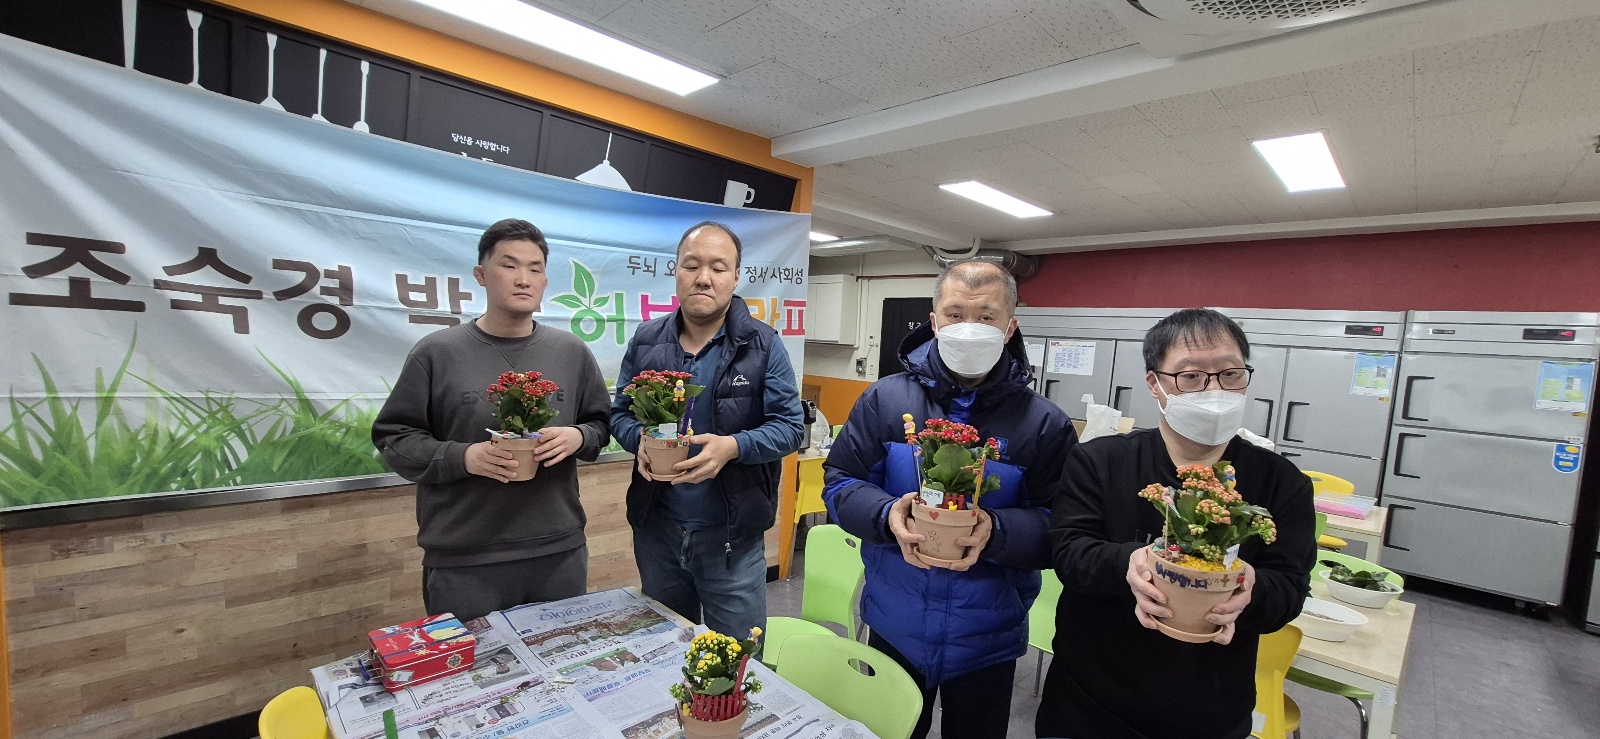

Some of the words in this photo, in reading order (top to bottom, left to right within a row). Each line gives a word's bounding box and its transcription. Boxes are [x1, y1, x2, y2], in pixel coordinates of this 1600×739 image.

[451, 133, 473, 146] 당신을
[475, 139, 511, 154] 사랑합니다
[626, 255, 657, 278] 두뇌
[9, 231, 354, 339] 조숙경
